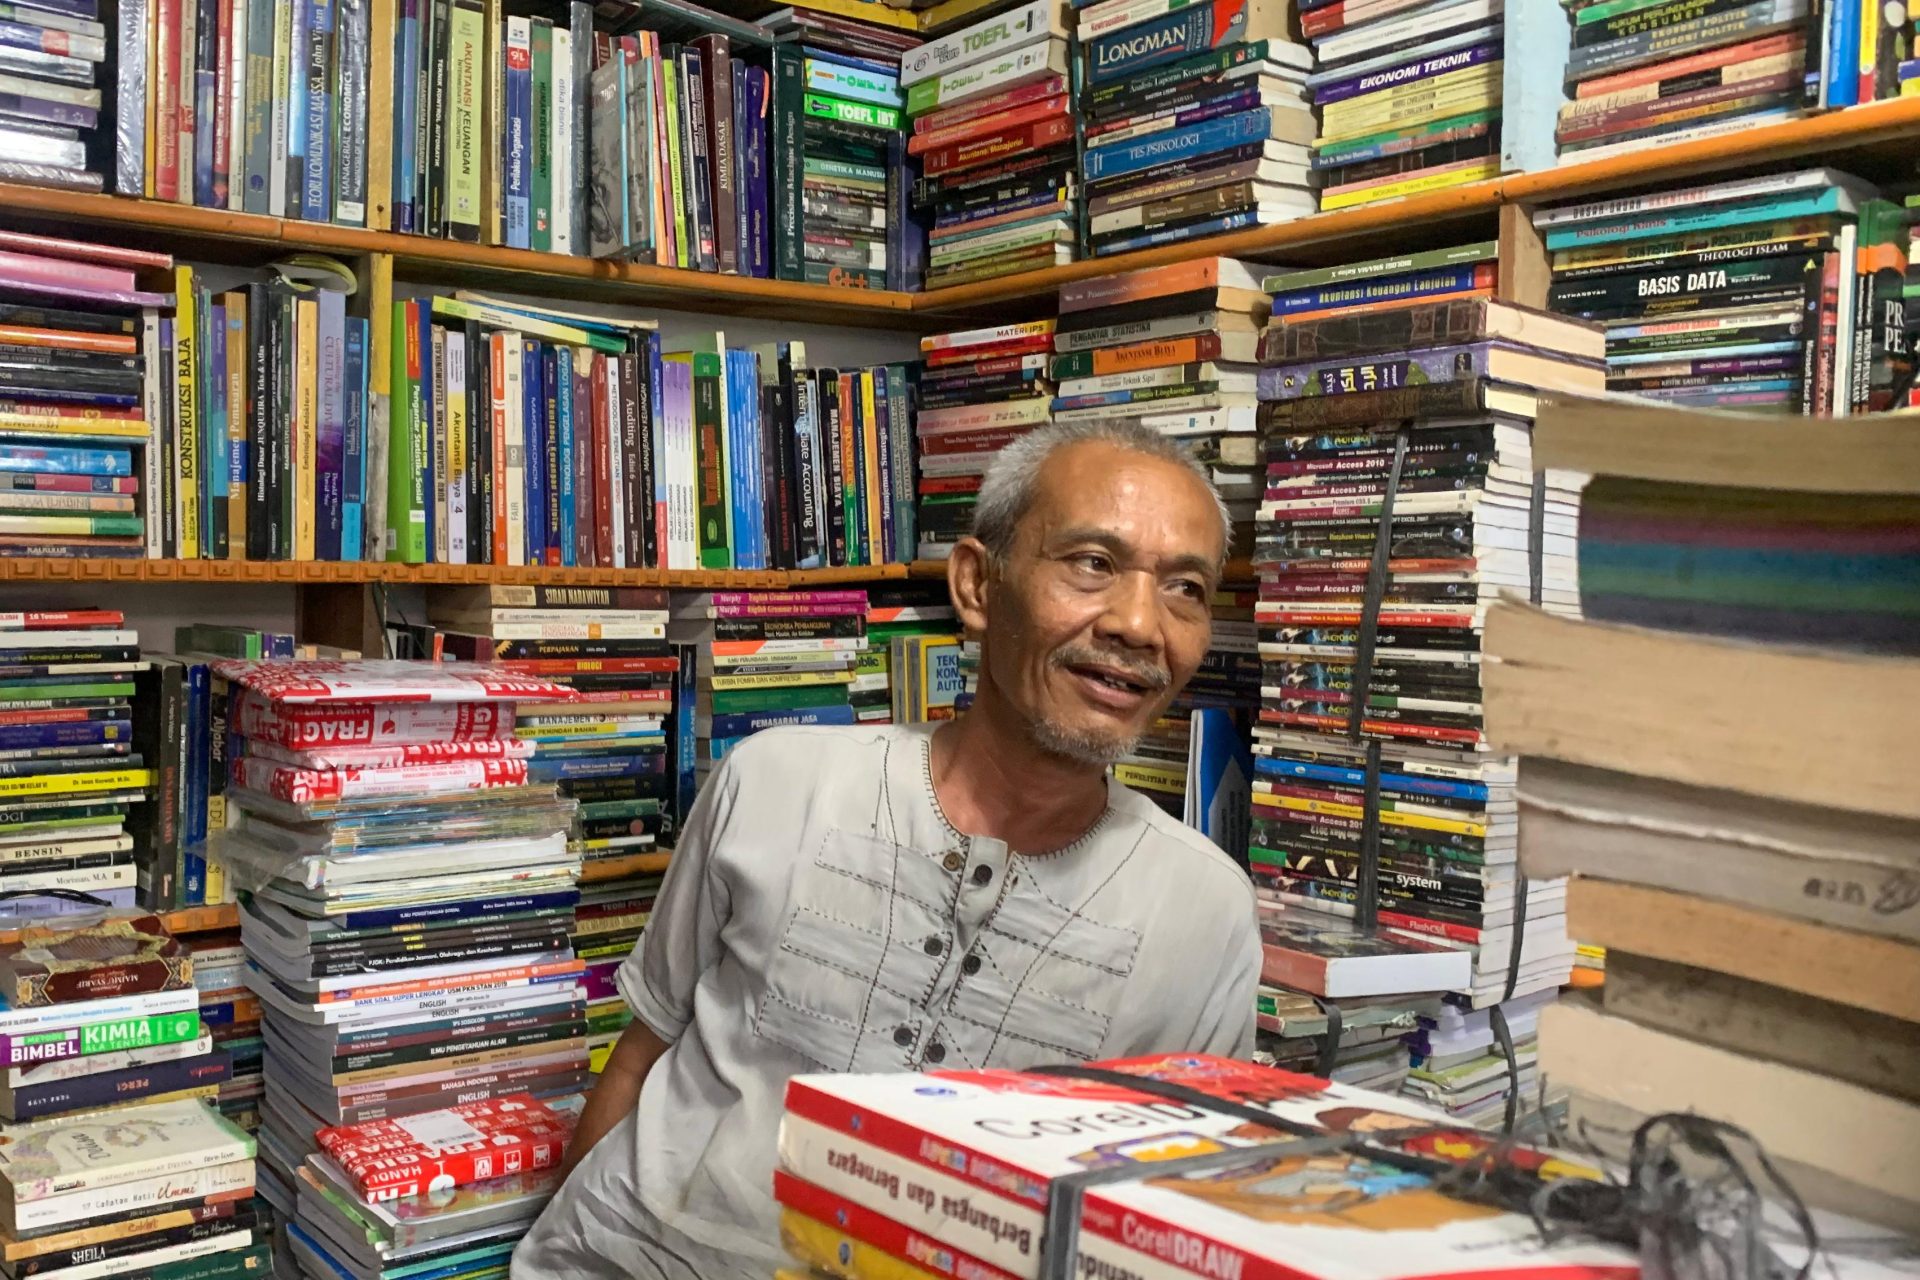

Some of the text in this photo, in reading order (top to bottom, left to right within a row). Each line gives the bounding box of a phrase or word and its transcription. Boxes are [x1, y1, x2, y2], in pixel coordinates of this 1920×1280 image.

[312, 9, 324, 69] John Vivian
[963, 22, 1012, 54] TOEFL
[1098, 23, 1186, 66] LONGMAN
[1182, 62, 1218, 78] Keuangan
[1359, 50, 1473, 90] EKONOMI TEKNIK
[342, 71, 351, 132] ECONOMICS
[462, 41, 473, 175] AKUNTANSI KEUANGAN
[837, 104, 873, 122] TOEFL
[575, 104, 584, 188] Exceptional Learners
[717, 120, 728, 189] KIMIA DASAR
[1146, 133, 1200, 157] PSIKOLOGI
[308, 112, 324, 208] TEORI KOMUNIKASI
[341, 135, 351, 196] MANAGERIAL
[820, 163, 854, 175] GENETIKA
[785, 111, 796, 237] Precision Machine Design
[1698, 243, 1788, 263] THEOLOGI ISLAM
[828, 267, 867, 289] C++
[1319, 275, 1456, 304] Akuntansi Keuangan Lanjutan
[1637, 269, 1727, 297] BASIS DATA
[995, 324, 1044, 339] MATERI IPS
[1069, 322, 1151, 342] PENGANTAR STATISTIKA
[1803, 340, 1815, 401] Microsoft Excel
[177, 336, 193, 480] KONSTRUKSI BAJA
[257, 395, 265, 445] JUNQUEIRA
[560, 351, 572, 496] TEKNOLOGI PENGELASAN LOGAM
[625, 398, 636, 473] Auditing Edisi
[640, 382, 651, 472] MANAJEMEN KEUANGAN
[229, 372, 242, 500] Manajemen Pemasaran
[411, 384, 424, 504] Pengantar Statistika Sosial
[830, 408, 841, 472] MANAJEMEN
[452, 411, 461, 498] Akuntansi Biaya
[798, 384, 814, 528] Intermediate Accounting
[1306, 459, 1385, 470] Microsoft Access 2010
[879, 427, 891, 520] Manajemen Strategis
[1301, 484, 1377, 496] Microsoft Access 2010
[1331, 561, 1368, 569] GEOGRAFIS
[544, 588, 568, 605] SIRAH
[720, 593, 742, 604] Murphy
[1295, 584, 1350, 594] Microsoft Access
[719, 605, 740, 615] Murphy
[539, 645, 580, 654] PERPAJAKAN
[854, 657, 880, 668] ublic
[936, 667, 960, 680] KON
[296, 719, 370, 743] FRAG
[537, 726, 598, 736] PEMINDAH BAHAN
[538, 715, 591, 725] MANAJEMEN
[750, 714, 818, 729] PEMASARAN JASA
[209, 715, 226, 763] Aljabar
[1289, 811, 1347, 827] Microsoft Access
[15, 846, 63, 859] BENSIN
[1396, 874, 1442, 891] system
[385, 955, 415, 966] Pendidikan
[439, 950, 465, 960] Olahraga,
[354, 981, 508, 1008] BANK SOAL SUPER LENGKAP USM PKN STAN 2019
[419, 999, 447, 1009] ENGLISH
[431, 1008, 460, 1018] ENGLISH
[85, 1020, 151, 1044] KIMIA
[10, 1041, 79, 1062] BIMBEL
[430, 1037, 508, 1056] ILMU PENGETAHUAN ALAM
[441, 1075, 499, 1091] BAHASA INDONESIA
[457, 1090, 491, 1104] ENGLISH
[973, 1099, 1207, 1139] CorelD
[826, 1147, 1032, 1256] Berbangsa dan Bernegara
[71, 1246, 106, 1265] SHEILA
[1121, 1212, 1244, 1280] CorelDRAW
